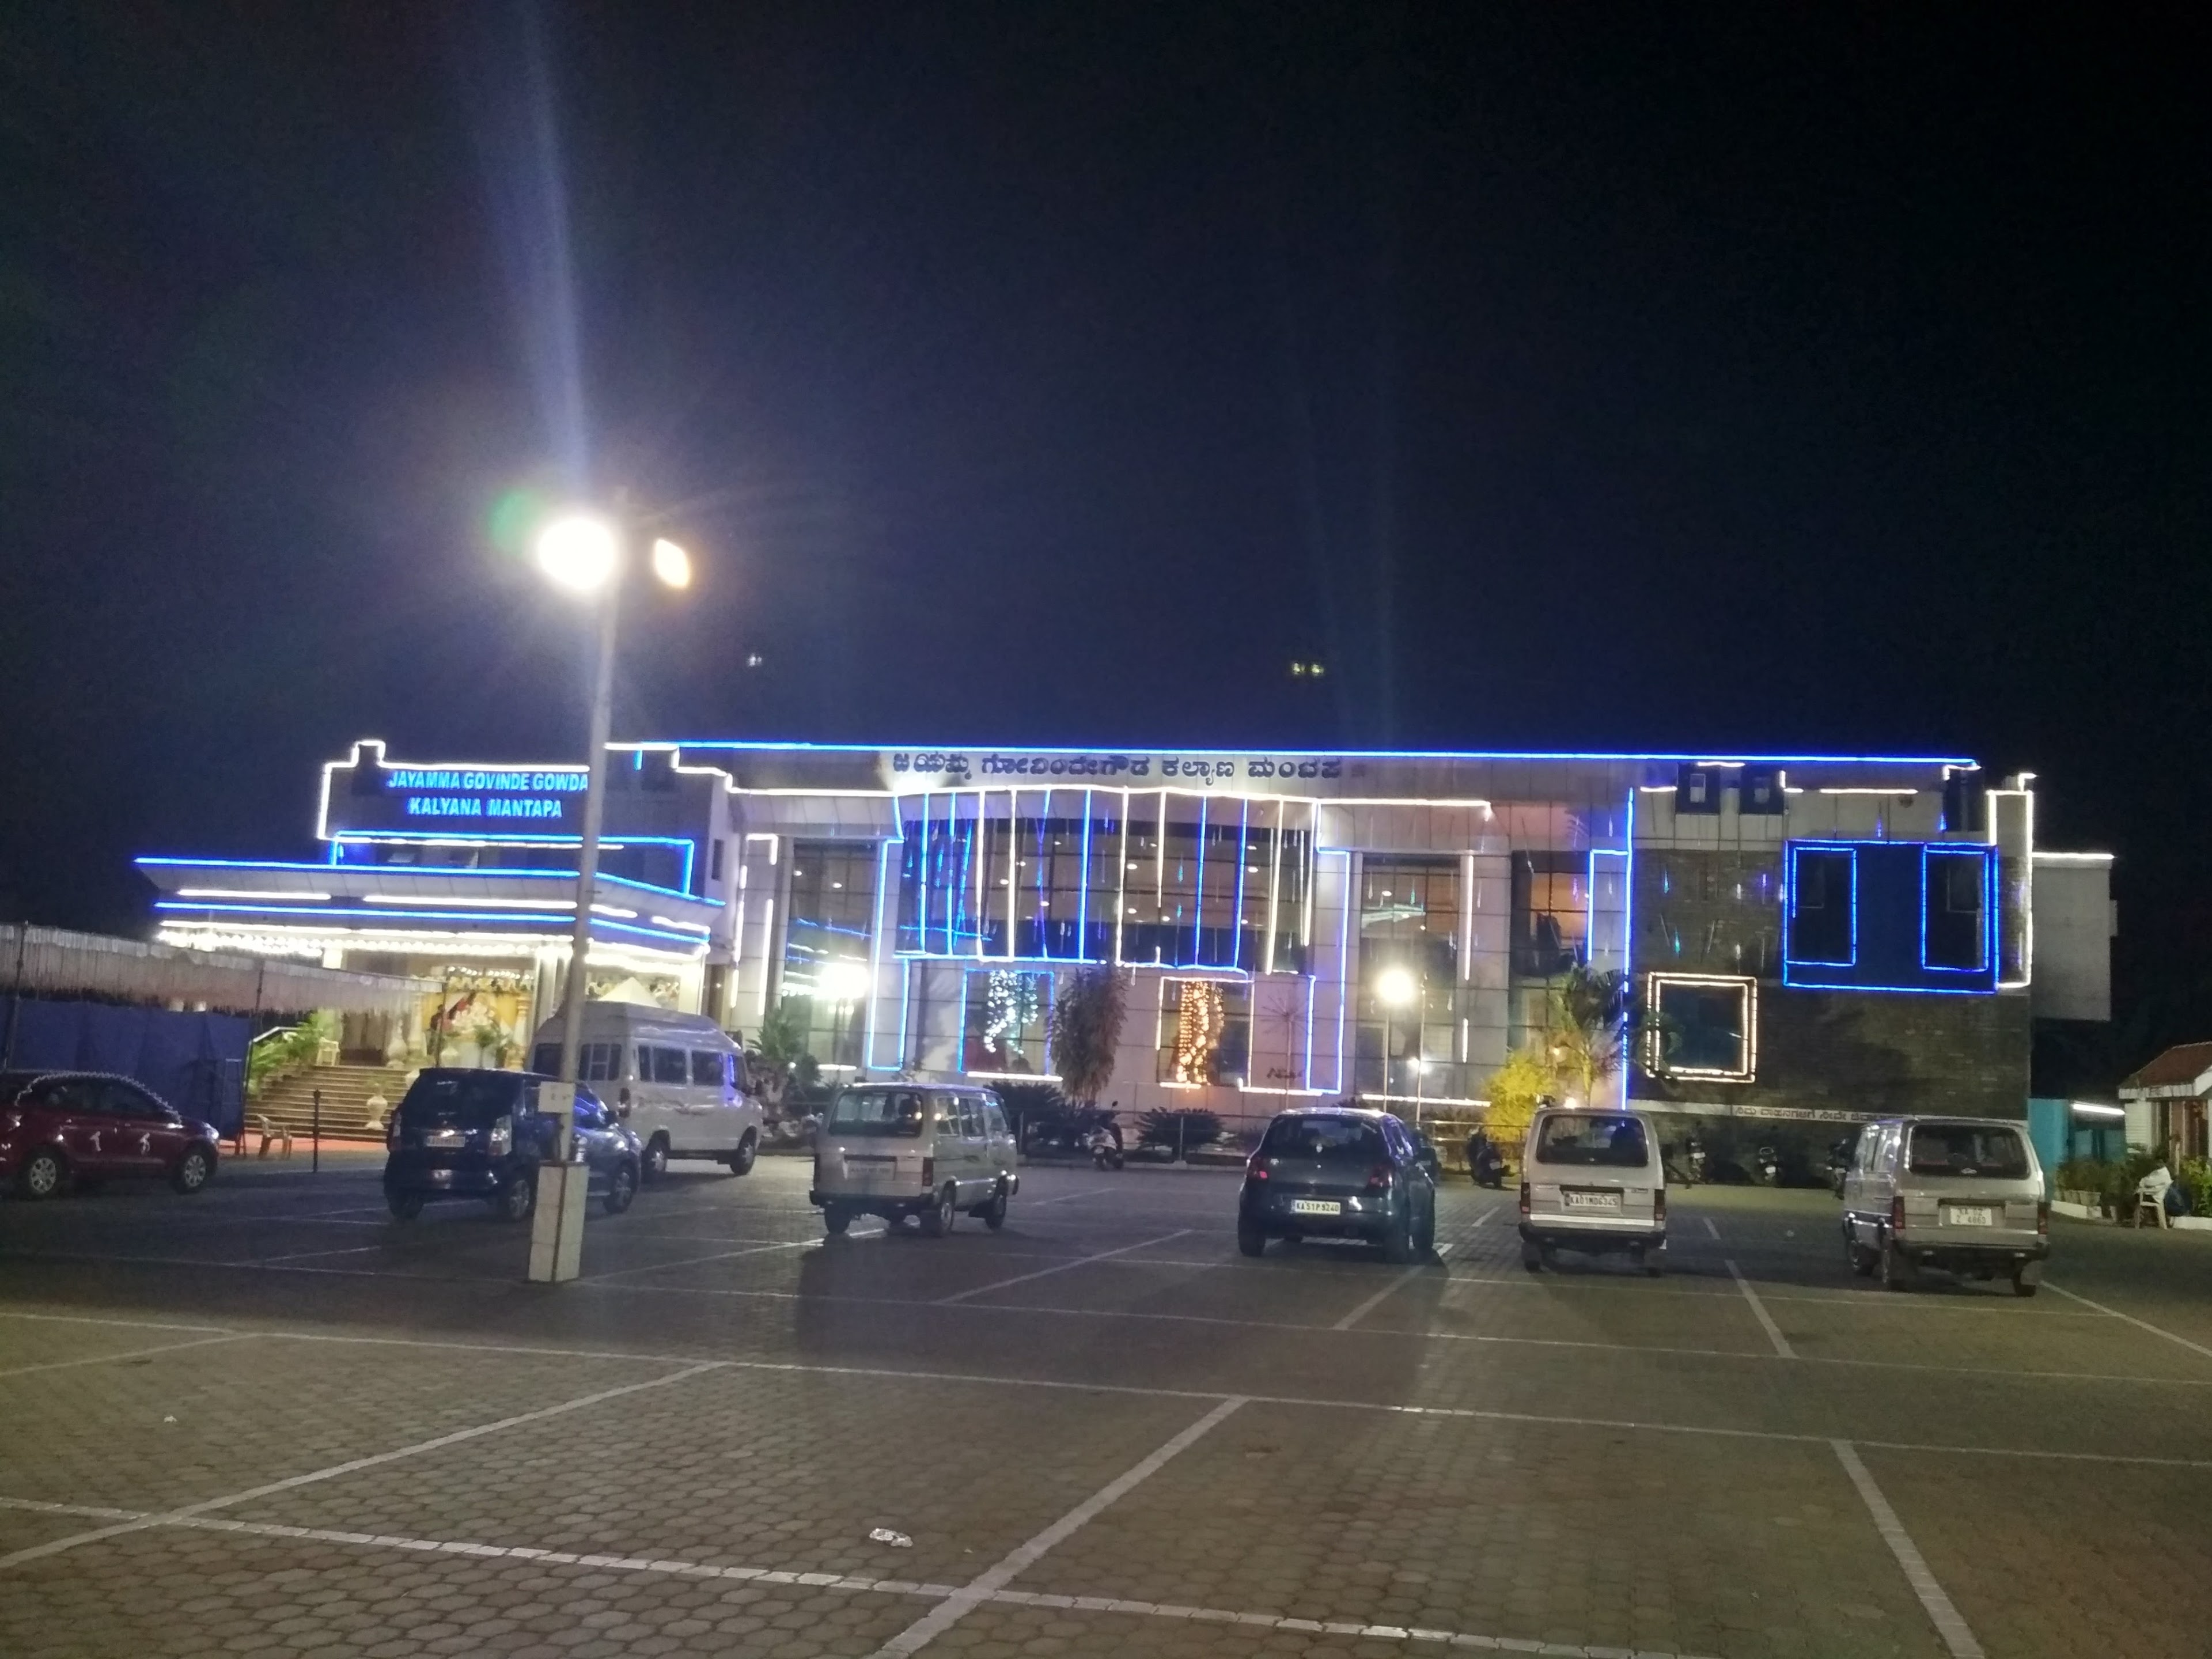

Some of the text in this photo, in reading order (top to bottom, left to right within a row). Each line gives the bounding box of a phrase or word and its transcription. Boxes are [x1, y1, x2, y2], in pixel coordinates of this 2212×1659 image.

[893, 751, 972, 780] ಜಯಮ್ಮ
[1162, 756, 1234, 786] ಕಲ್ಯಾಣ
[1248, 756, 1341, 779] ಮಂಟಪ
[388, 771, 588, 791] JAYAMMA GOVINDE GOWDA
[408, 797, 562, 817] KALYANA MANTAPA
